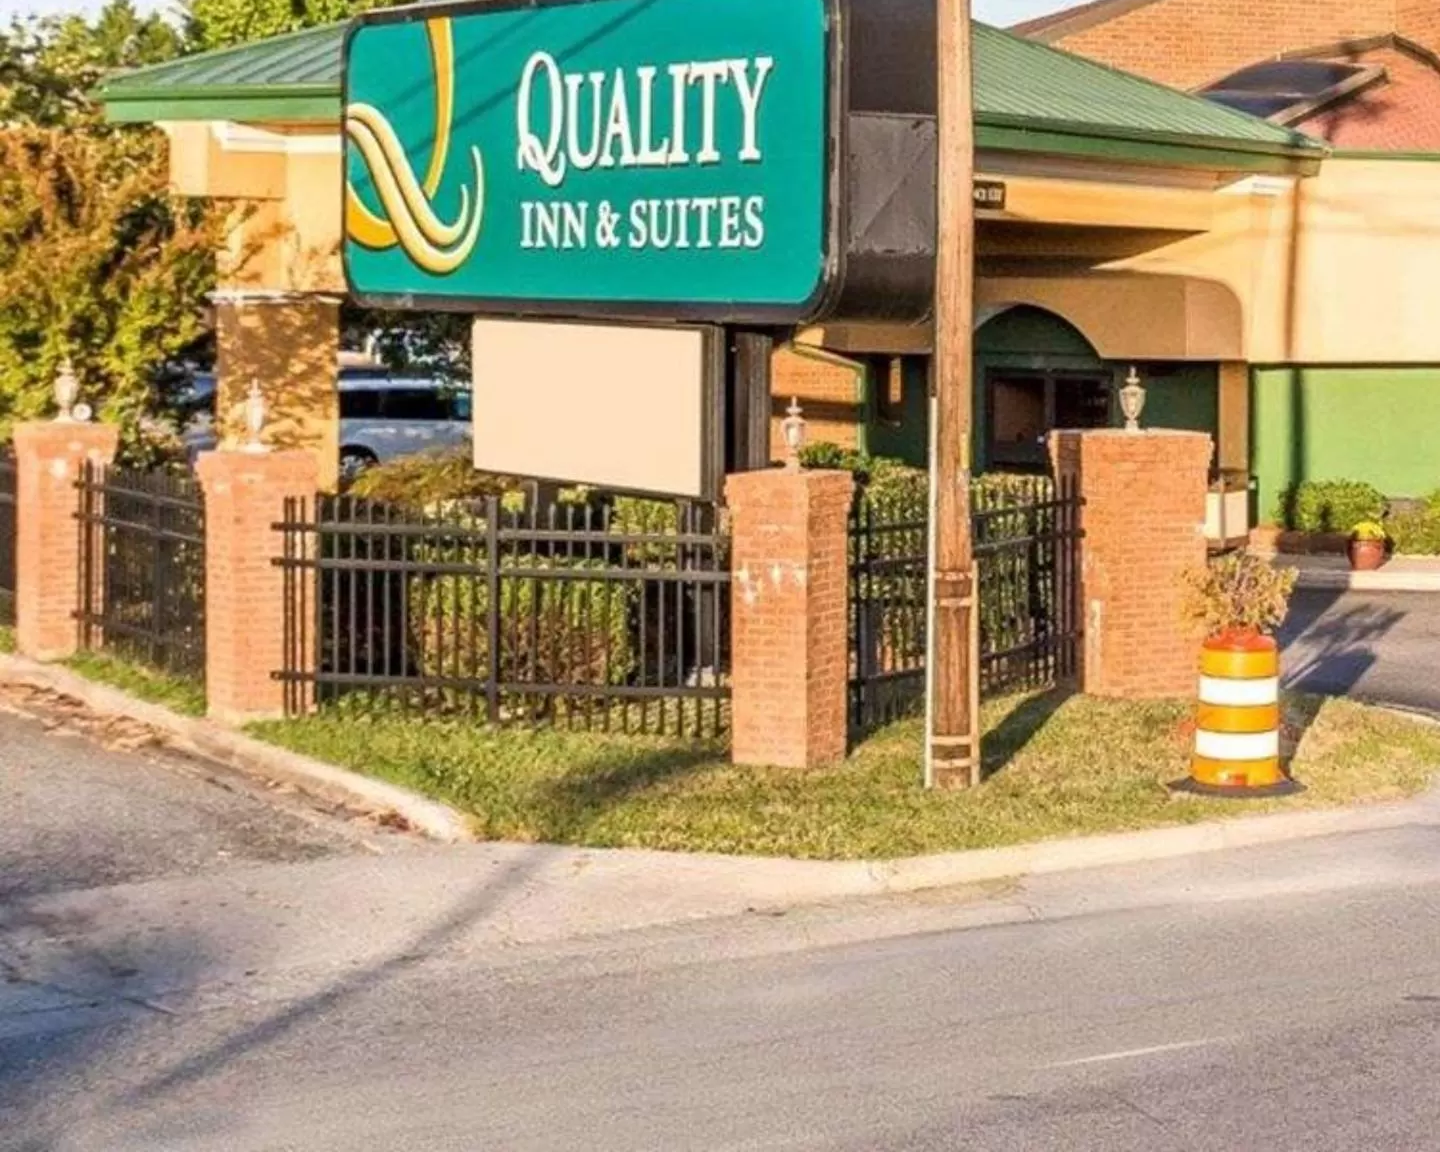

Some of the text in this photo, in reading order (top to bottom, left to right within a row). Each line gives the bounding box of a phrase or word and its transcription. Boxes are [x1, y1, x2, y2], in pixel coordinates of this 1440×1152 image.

[516, 51, 773, 186] QUALITY
[519, 195, 765, 249] INN & SUITES
